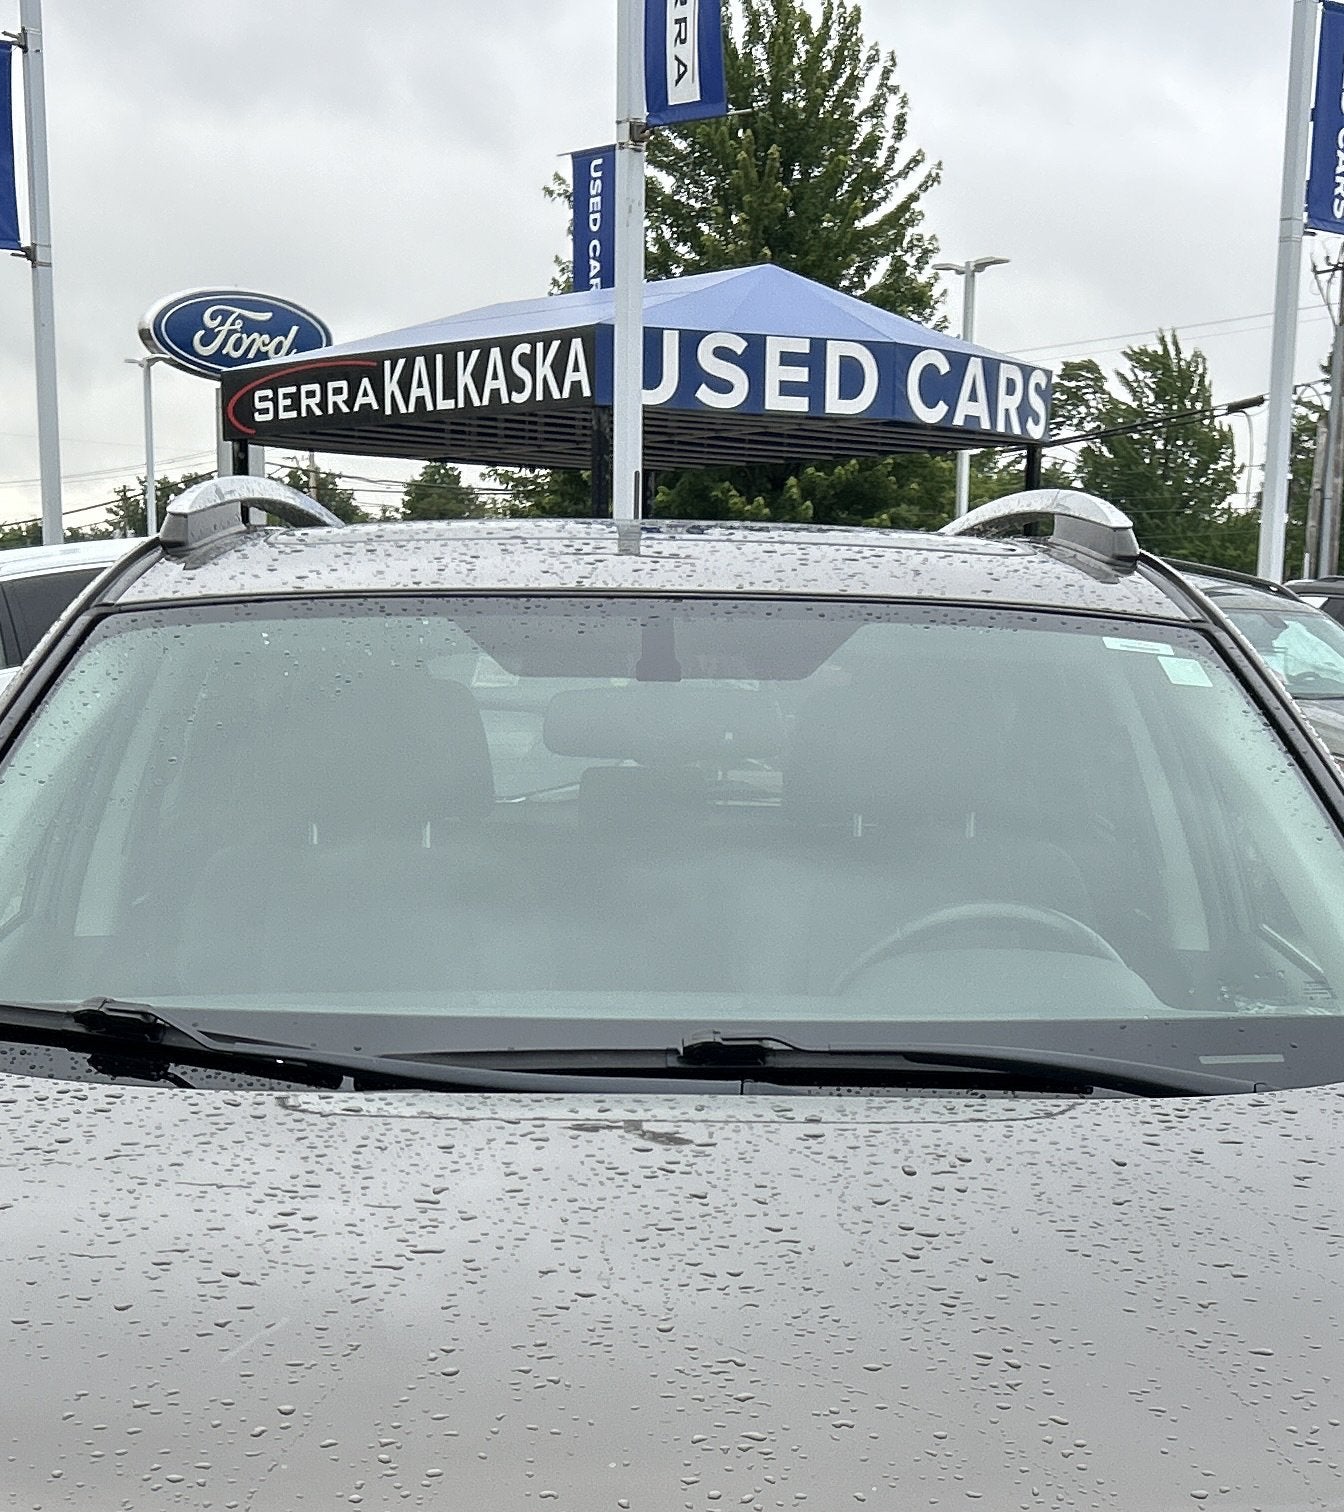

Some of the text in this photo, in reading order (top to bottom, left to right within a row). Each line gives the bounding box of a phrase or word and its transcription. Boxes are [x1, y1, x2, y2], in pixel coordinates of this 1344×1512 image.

[588, 158, 604, 291] USED CAR
[193, 304, 300, 359] Ford
[253, 337, 592, 422] SERRA KALKASKA
[641, 329, 1051, 440] USED CARS
